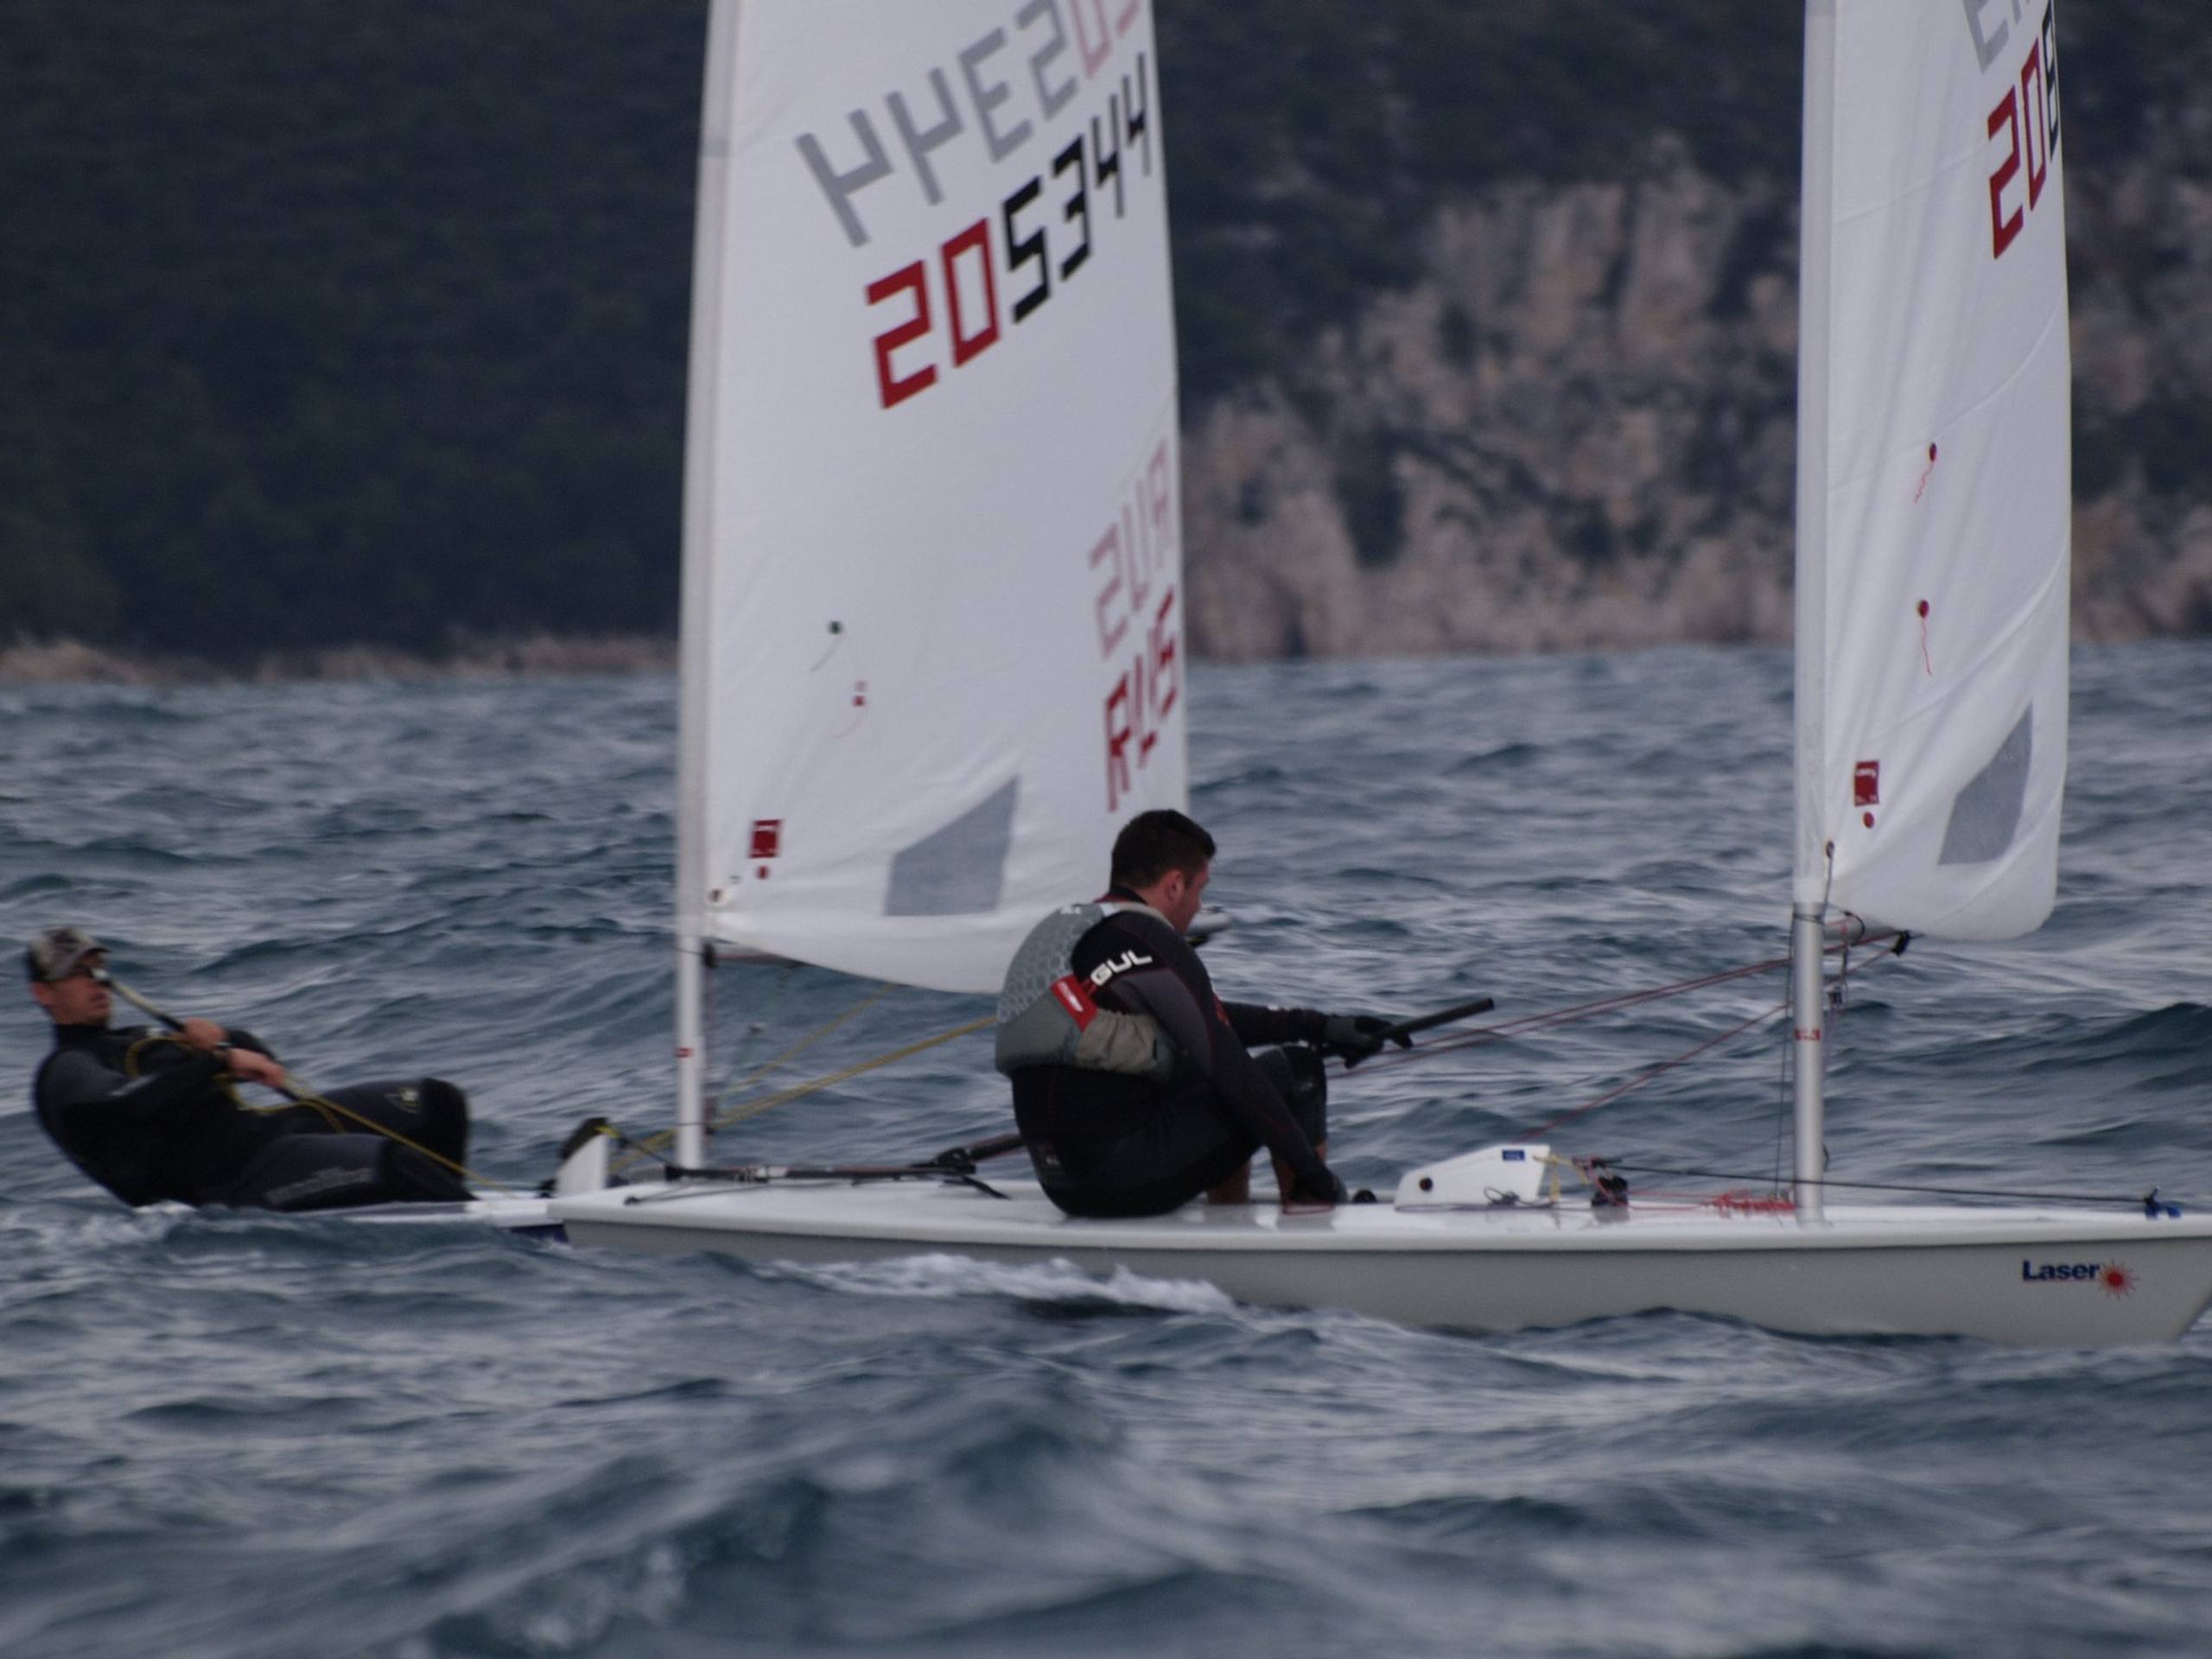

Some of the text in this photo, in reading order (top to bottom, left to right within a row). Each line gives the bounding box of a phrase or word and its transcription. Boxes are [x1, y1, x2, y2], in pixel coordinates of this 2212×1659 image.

[864, 53, 1151, 410] 205344
[1090, 950, 1153, 986] GUL
[2022, 1260, 2101, 1281] Laser
